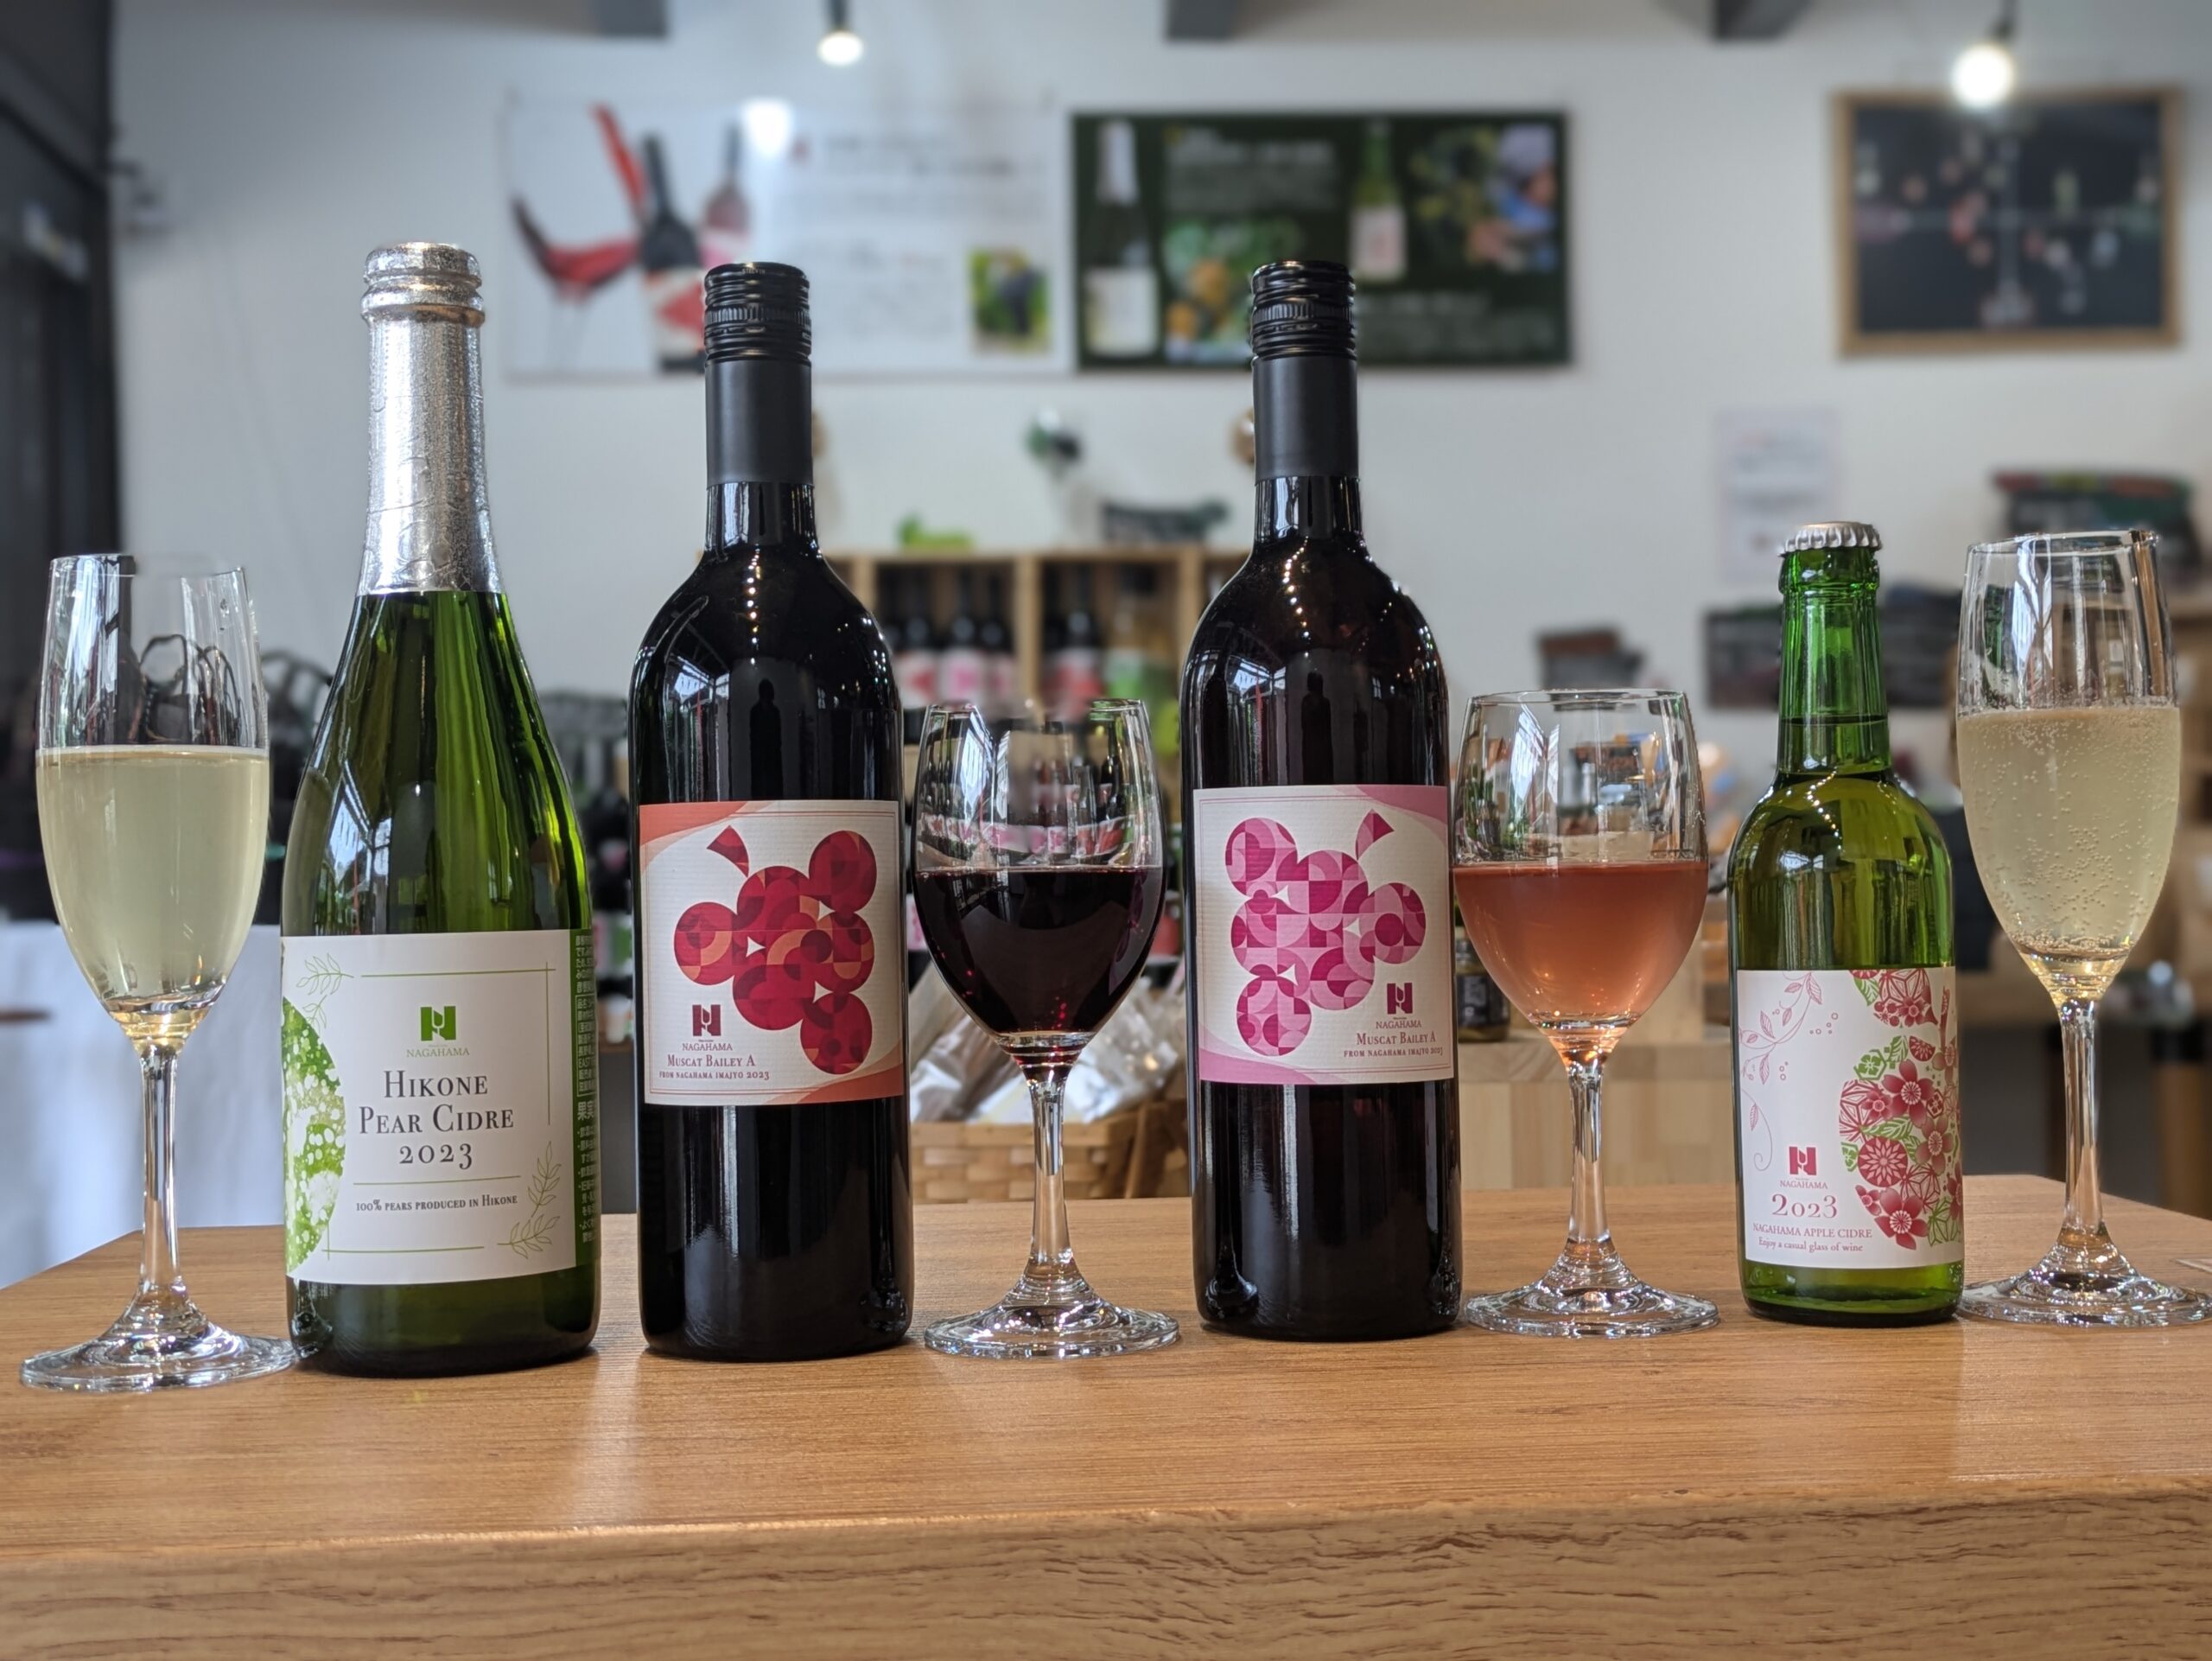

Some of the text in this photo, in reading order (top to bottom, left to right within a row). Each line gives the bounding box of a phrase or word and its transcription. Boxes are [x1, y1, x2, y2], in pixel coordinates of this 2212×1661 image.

[1376, 1020, 1421, 1029] NAGAHAMA
[1430, 1031, 1436, 1042] A
[406, 1047, 470, 1058] NAGAHAMA
[682, 1043, 733, 1052] NAGAHAMA
[746, 1054, 756, 1066] A
[747, 1072, 770, 1080] 2023
[399, 1142, 473, 1170] 2023
[1780, 1180, 1828, 1190] NAGAHAMA
[356, 1200, 381, 1212] 100%
[385, 1202, 412, 1212] PEARS
[416, 1200, 466, 1211] PRODUCED
[469, 1198, 479, 1207] IN
[1771, 1193, 1838, 1219] 2023
[1752, 1223, 1872, 1238] NAGAHAMA APPLE CIDRE
[1758, 1237, 1777, 1250] Enjoy
[1783, 1240, 1807, 1251] casual
[1808, 1241, 1828, 1252] glass
[1830, 1242, 1841, 1251] of
[1842, 1244, 1864, 1252] wine
